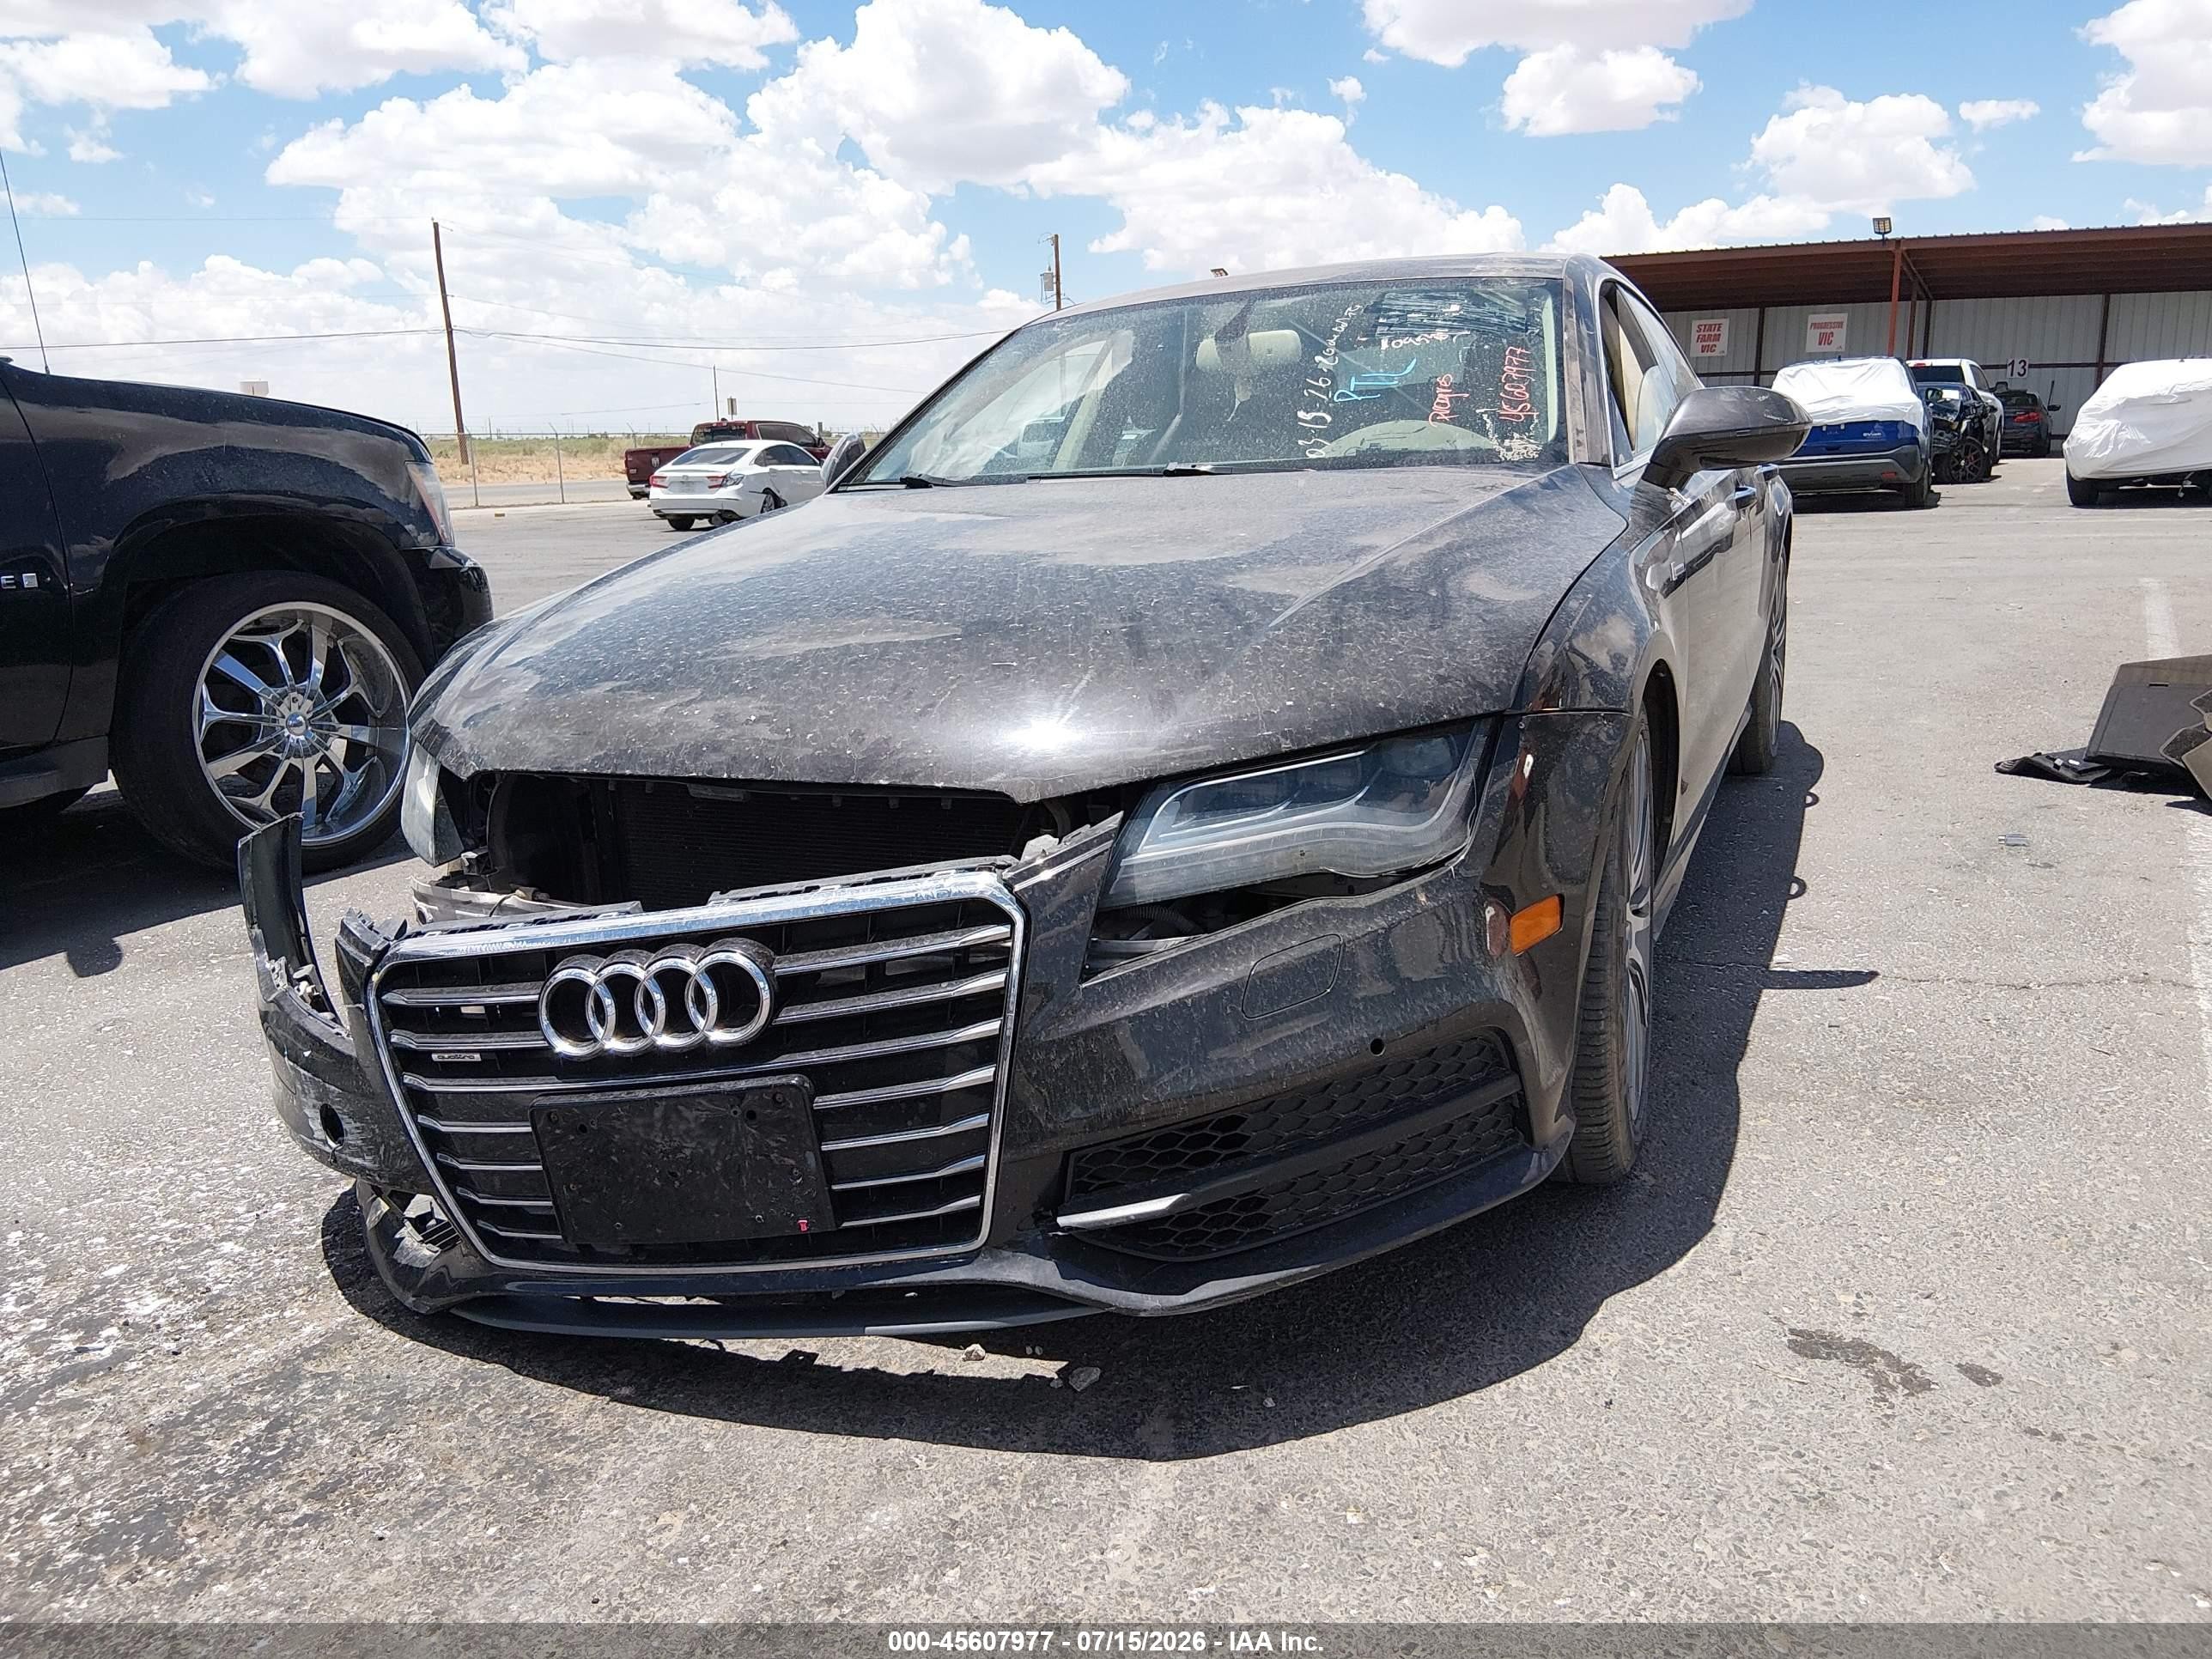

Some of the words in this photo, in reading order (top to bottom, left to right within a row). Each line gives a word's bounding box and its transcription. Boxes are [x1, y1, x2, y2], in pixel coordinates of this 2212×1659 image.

[1696, 323, 1723, 333] STATE
[1696, 333, 1722, 343] FARM
[1818, 331, 1834, 346] VIC
[1700, 343, 1717, 354] VIC
[2008, 359, 2027, 377] 13
